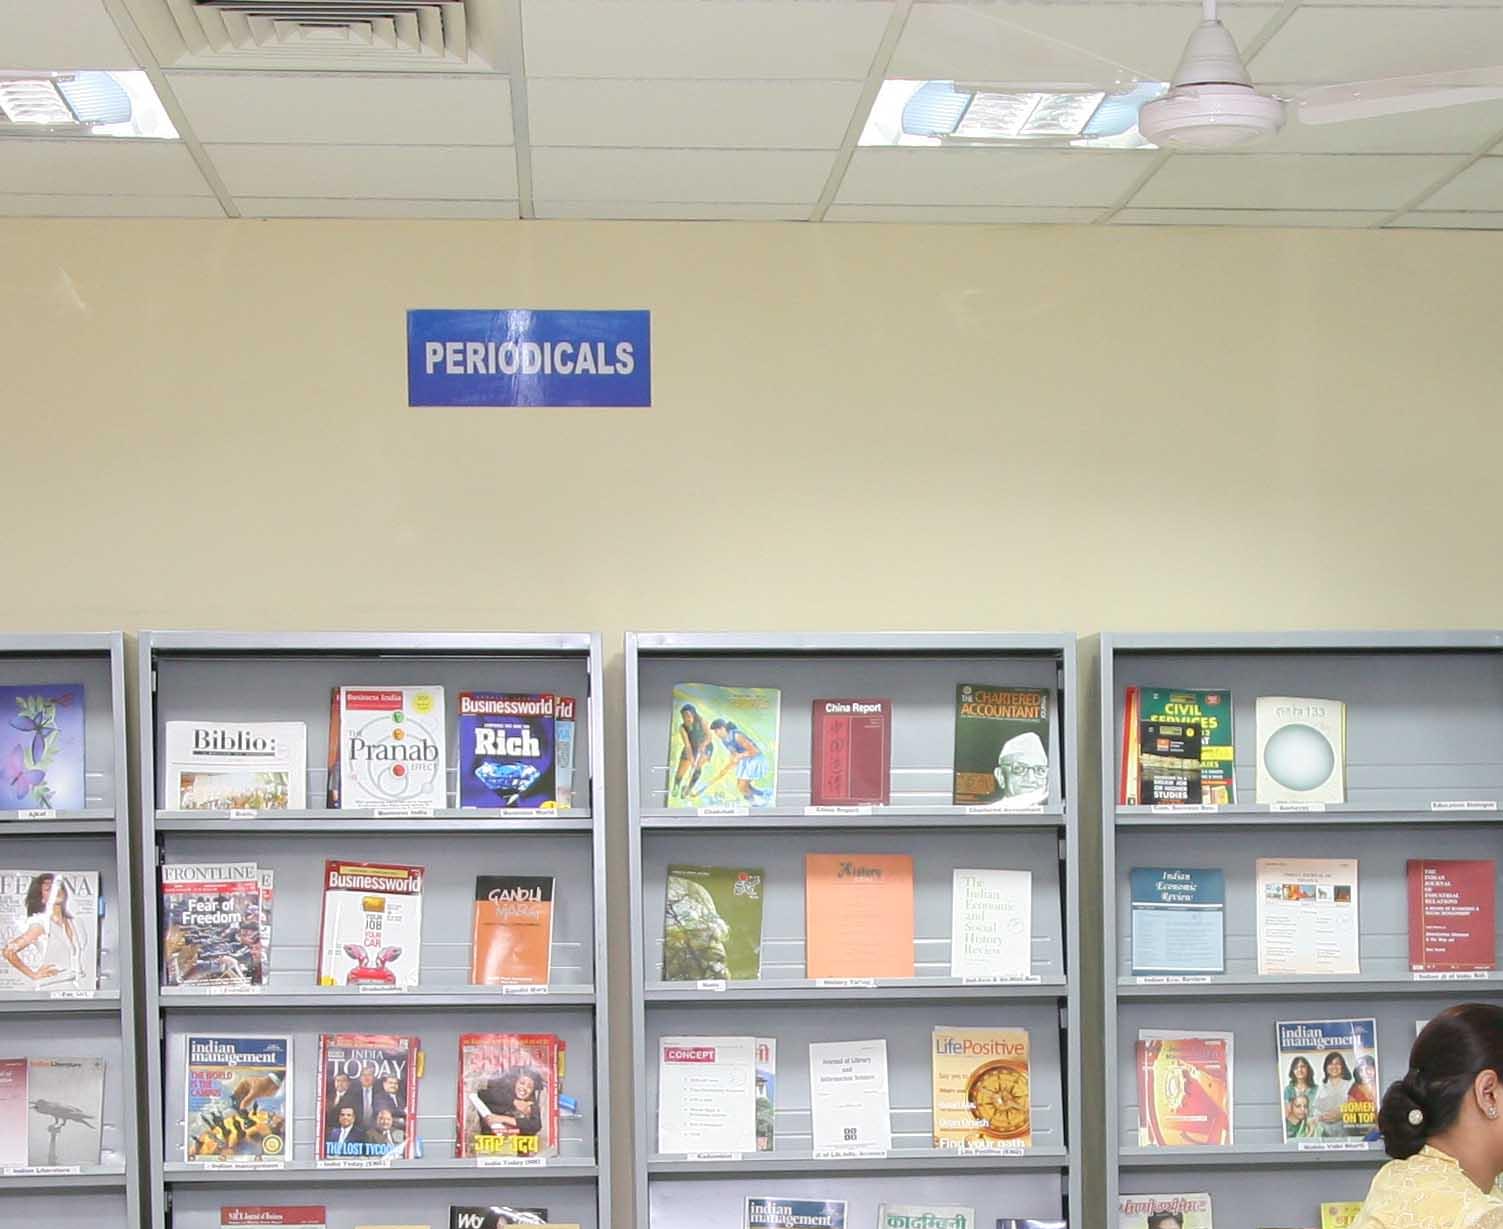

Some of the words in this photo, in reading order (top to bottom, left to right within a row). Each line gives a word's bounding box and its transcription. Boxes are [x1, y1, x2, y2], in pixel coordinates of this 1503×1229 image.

[425, 341, 635, 375] PERIODICALS
[976, 691, 1040, 705] CHARTERED
[461, 697, 554, 716] Businessworld
[825, 703, 850, 713] China
[852, 703, 882, 714] Report
[961, 703, 1040, 718] ACCOUNTANT
[1165, 703, 1202, 716] CIVIL
[192, 728, 277, 752] Biblio:
[475, 726, 541, 757] Rich
[349, 738, 439, 761] Pranab
[410, 763, 437, 772] EFFECT
[1153, 791, 1188, 799] STUDIES
[165, 865, 255, 882] FRONTLINE
[1162, 871, 1191, 881] Indian
[1, 873, 94, 896] FENA
[329, 871, 422, 893] Businessworld
[1155, 881, 1198, 891] Economic
[965, 888, 1000, 899] Indian
[188, 897, 218, 911] Fear
[220, 897, 235, 910] of
[182, 911, 242, 925] Freedom
[964, 911, 985, 921] and
[365, 921, 382, 930] JOB
[363, 938, 381, 948] CAR
[964, 933, 1002, 945] History
[1281, 1026, 1322, 1039] indian
[191, 1041, 236, 1054] indian
[936, 1039, 1025, 1056] LifePositive
[1282, 1035, 1361, 1049] management
[191, 1052, 277, 1066] management
[350, 1051, 384, 1060] INDIA
[668, 1051, 714, 1059] CONCEPT
[328, 1059, 407, 1079] TODAY
[1340, 1102, 1375, 1113] WOMEN
[1343, 1113, 1356, 1123] ON
[1357, 1113, 1375, 1123] TOP
[344, 1142, 364, 1156] LOST
[751, 1202, 792, 1215] indian
[751, 1214, 833, 1227] management
